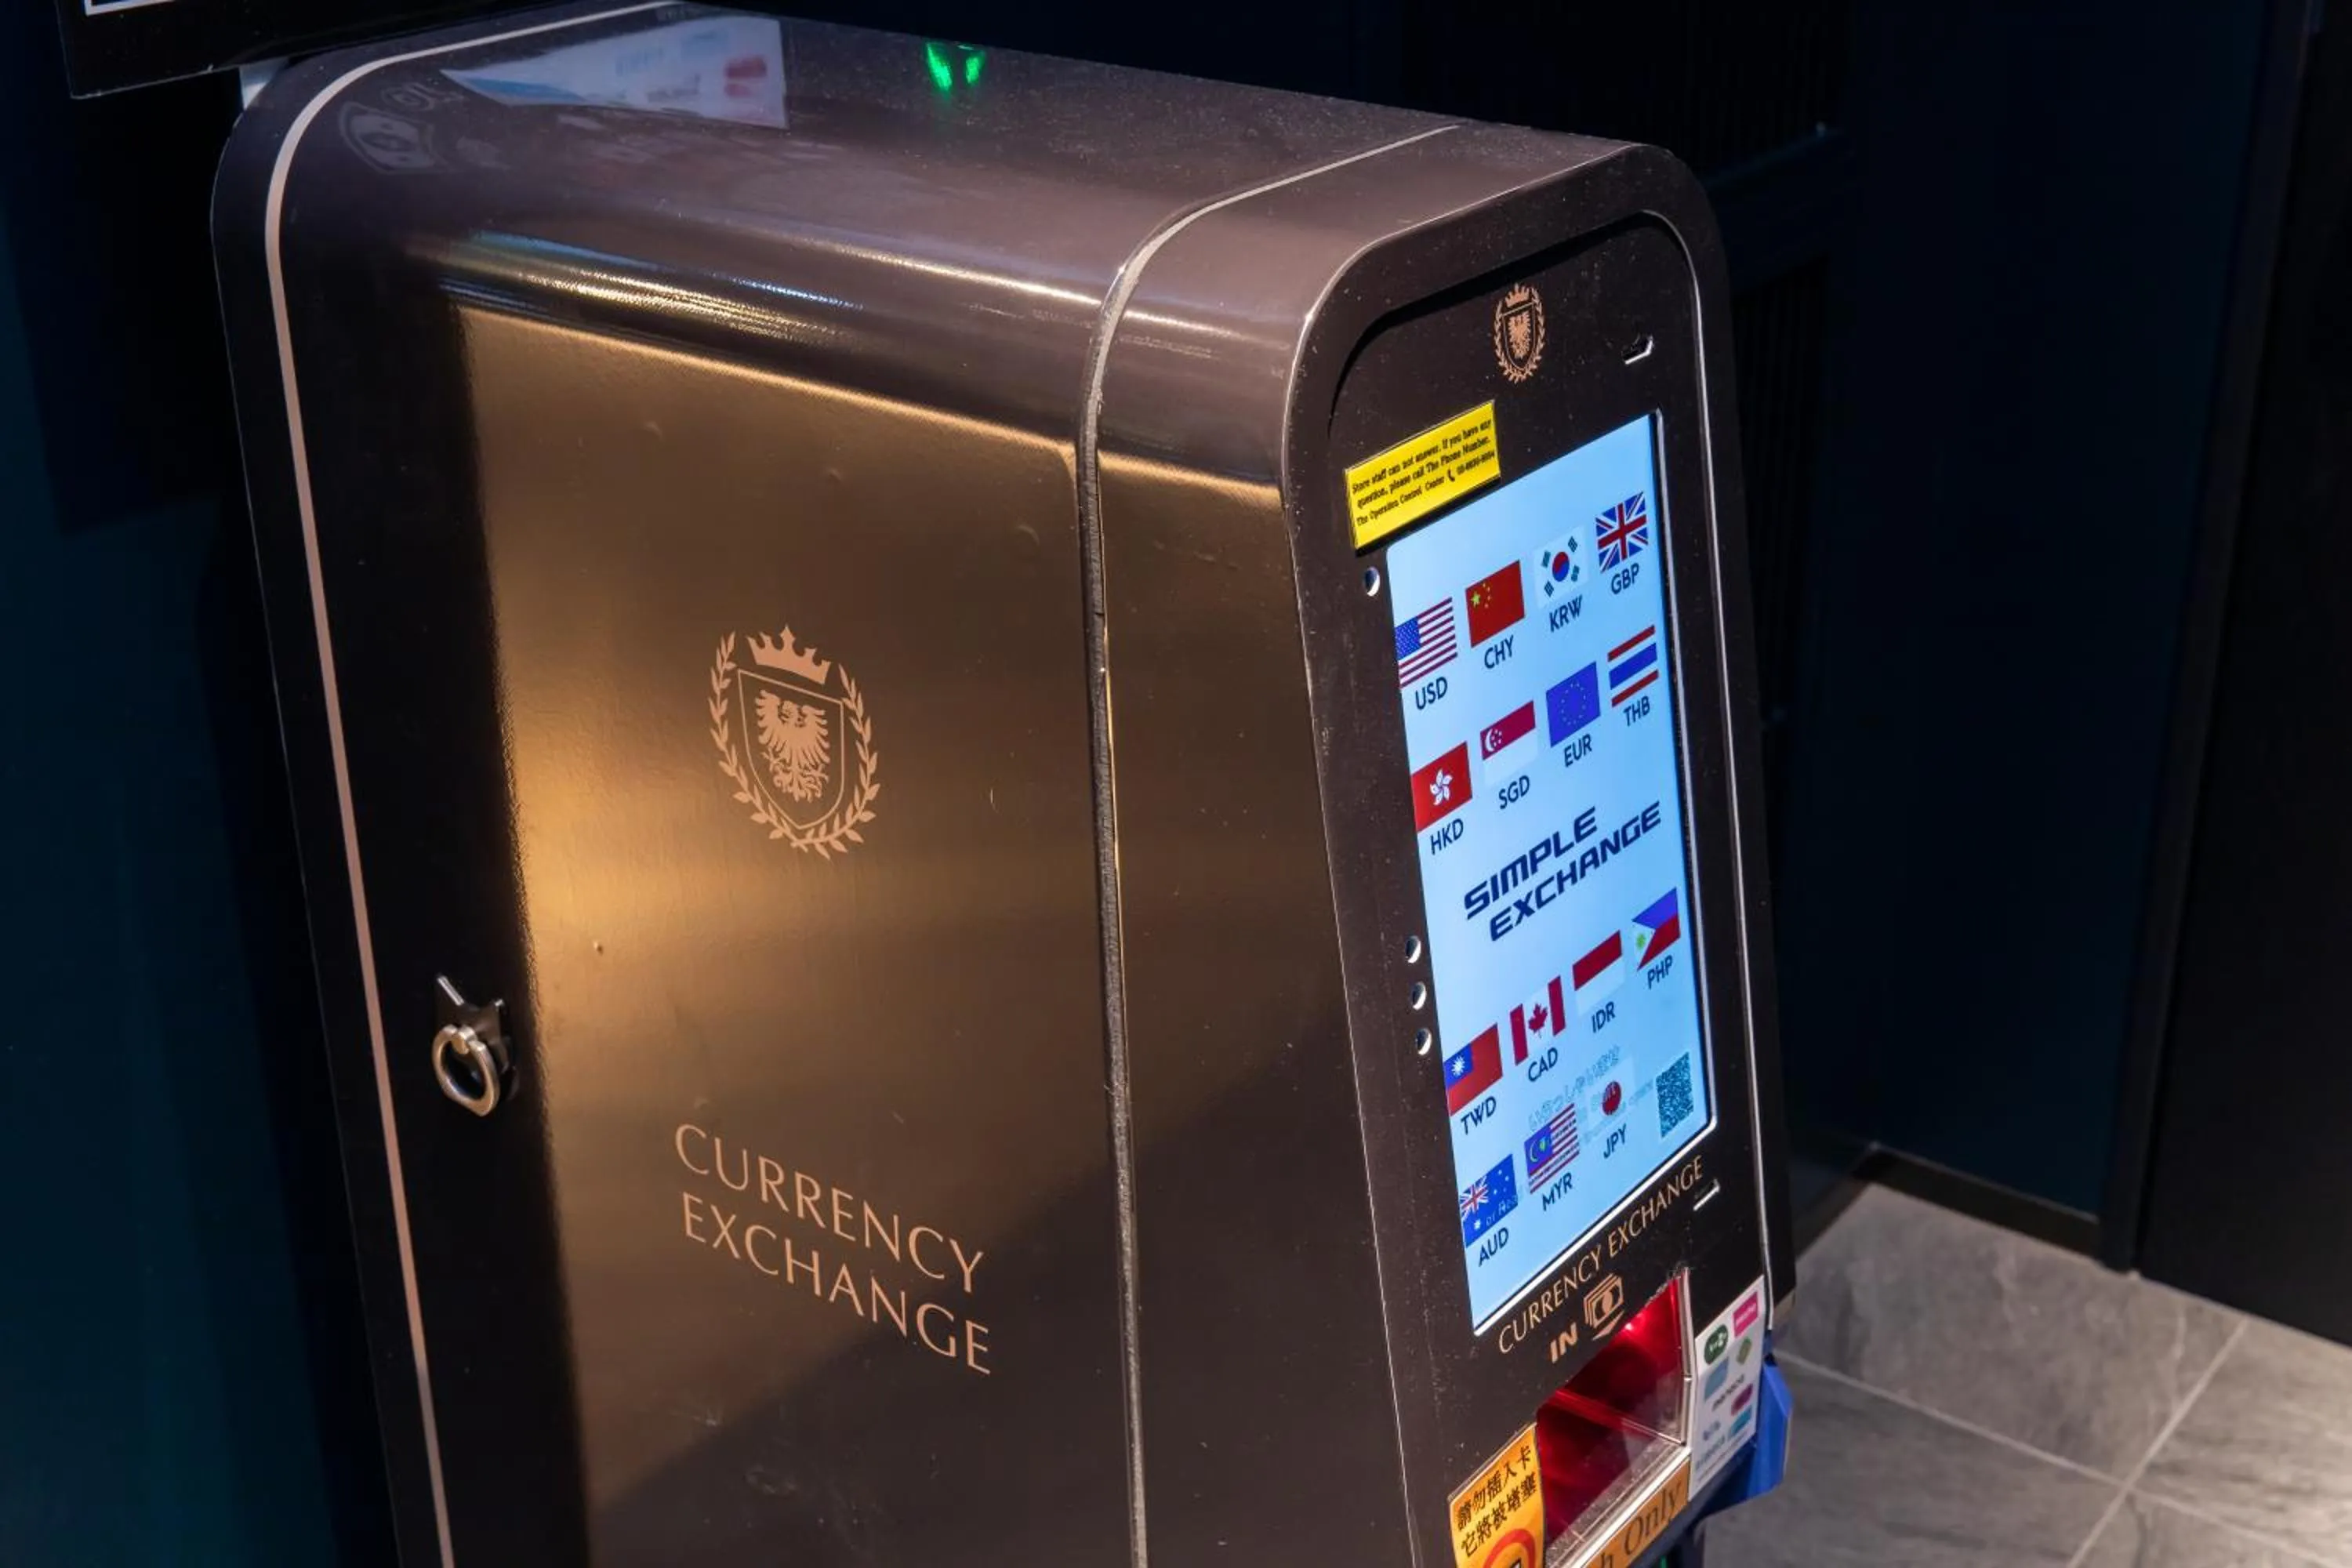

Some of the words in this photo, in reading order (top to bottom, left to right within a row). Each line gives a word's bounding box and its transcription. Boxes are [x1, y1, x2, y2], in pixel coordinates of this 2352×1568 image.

[1372, 468, 1387, 484] staff
[1450, 434, 1461, 448] you
[1462, 426, 1479, 439] have
[1389, 475, 1411, 495] please
[1412, 465, 1425, 480] call
[1441, 449, 1461, 466] Phone
[1610, 562, 1640, 596] GBP
[1548, 594, 1583, 633] KRW
[1483, 634, 1515, 670] CHY
[1415, 675, 1449, 710] USD
[1623, 695, 1650, 727] THB
[1563, 734, 1592, 768] EUR
[1497, 775, 1530, 810] SGD
[1430, 818, 1465, 855] HKD
[1464, 806, 1598, 920] SIMPLE
[1490, 800, 1662, 942] EXCHANGE
[1647, 955, 1673, 990] PHP
[1591, 1000, 1617, 1034] IDR
[1527, 1047, 1559, 1083] CAD
[1461, 1096, 1497, 1136] TWD
[1602, 1123, 1627, 1159] JPY
[675, 1123, 984, 1294] CURRENCY
[1541, 1171, 1573, 1211] MYR
[1478, 1227, 1509, 1268] AUD
[1497, 1244, 1602, 1356] CURRENCY
[1607, 1154, 1704, 1258] EXCHANGE
[682, 1191, 991, 1375] EXCHANGE
[1548, 1322, 1579, 1364] IN
[1624, 1480, 1682, 1555] Only
